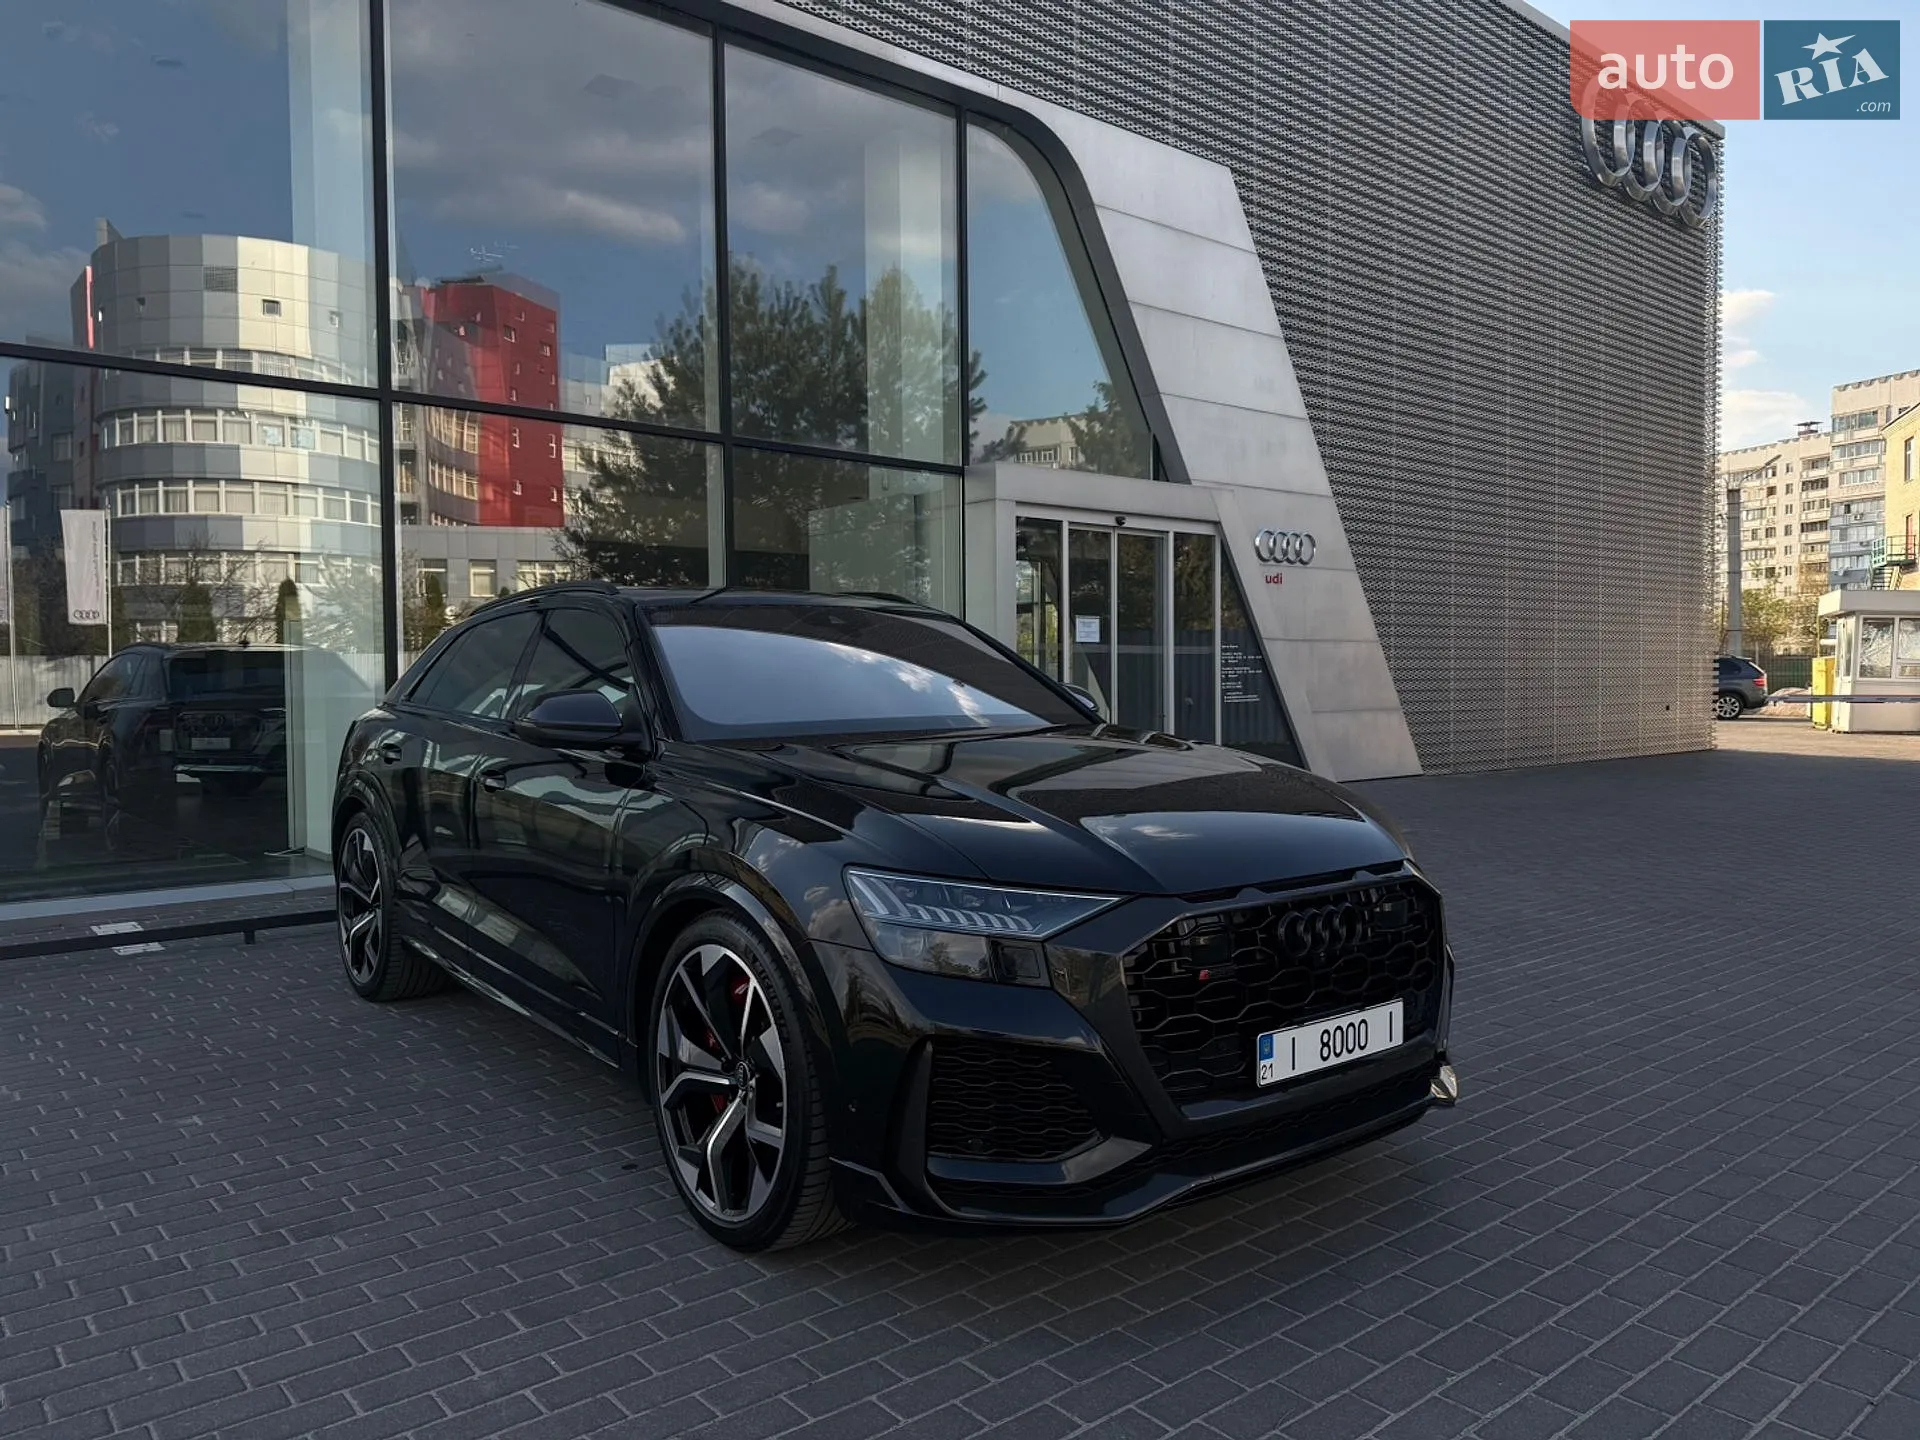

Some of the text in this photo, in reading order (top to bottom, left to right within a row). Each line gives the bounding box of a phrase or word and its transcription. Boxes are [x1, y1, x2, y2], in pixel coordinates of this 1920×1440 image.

[1265, 572, 1283, 584] udi
[1320, 1018, 1369, 1062] 8000
[1261, 1063, 1274, 1080] 21
